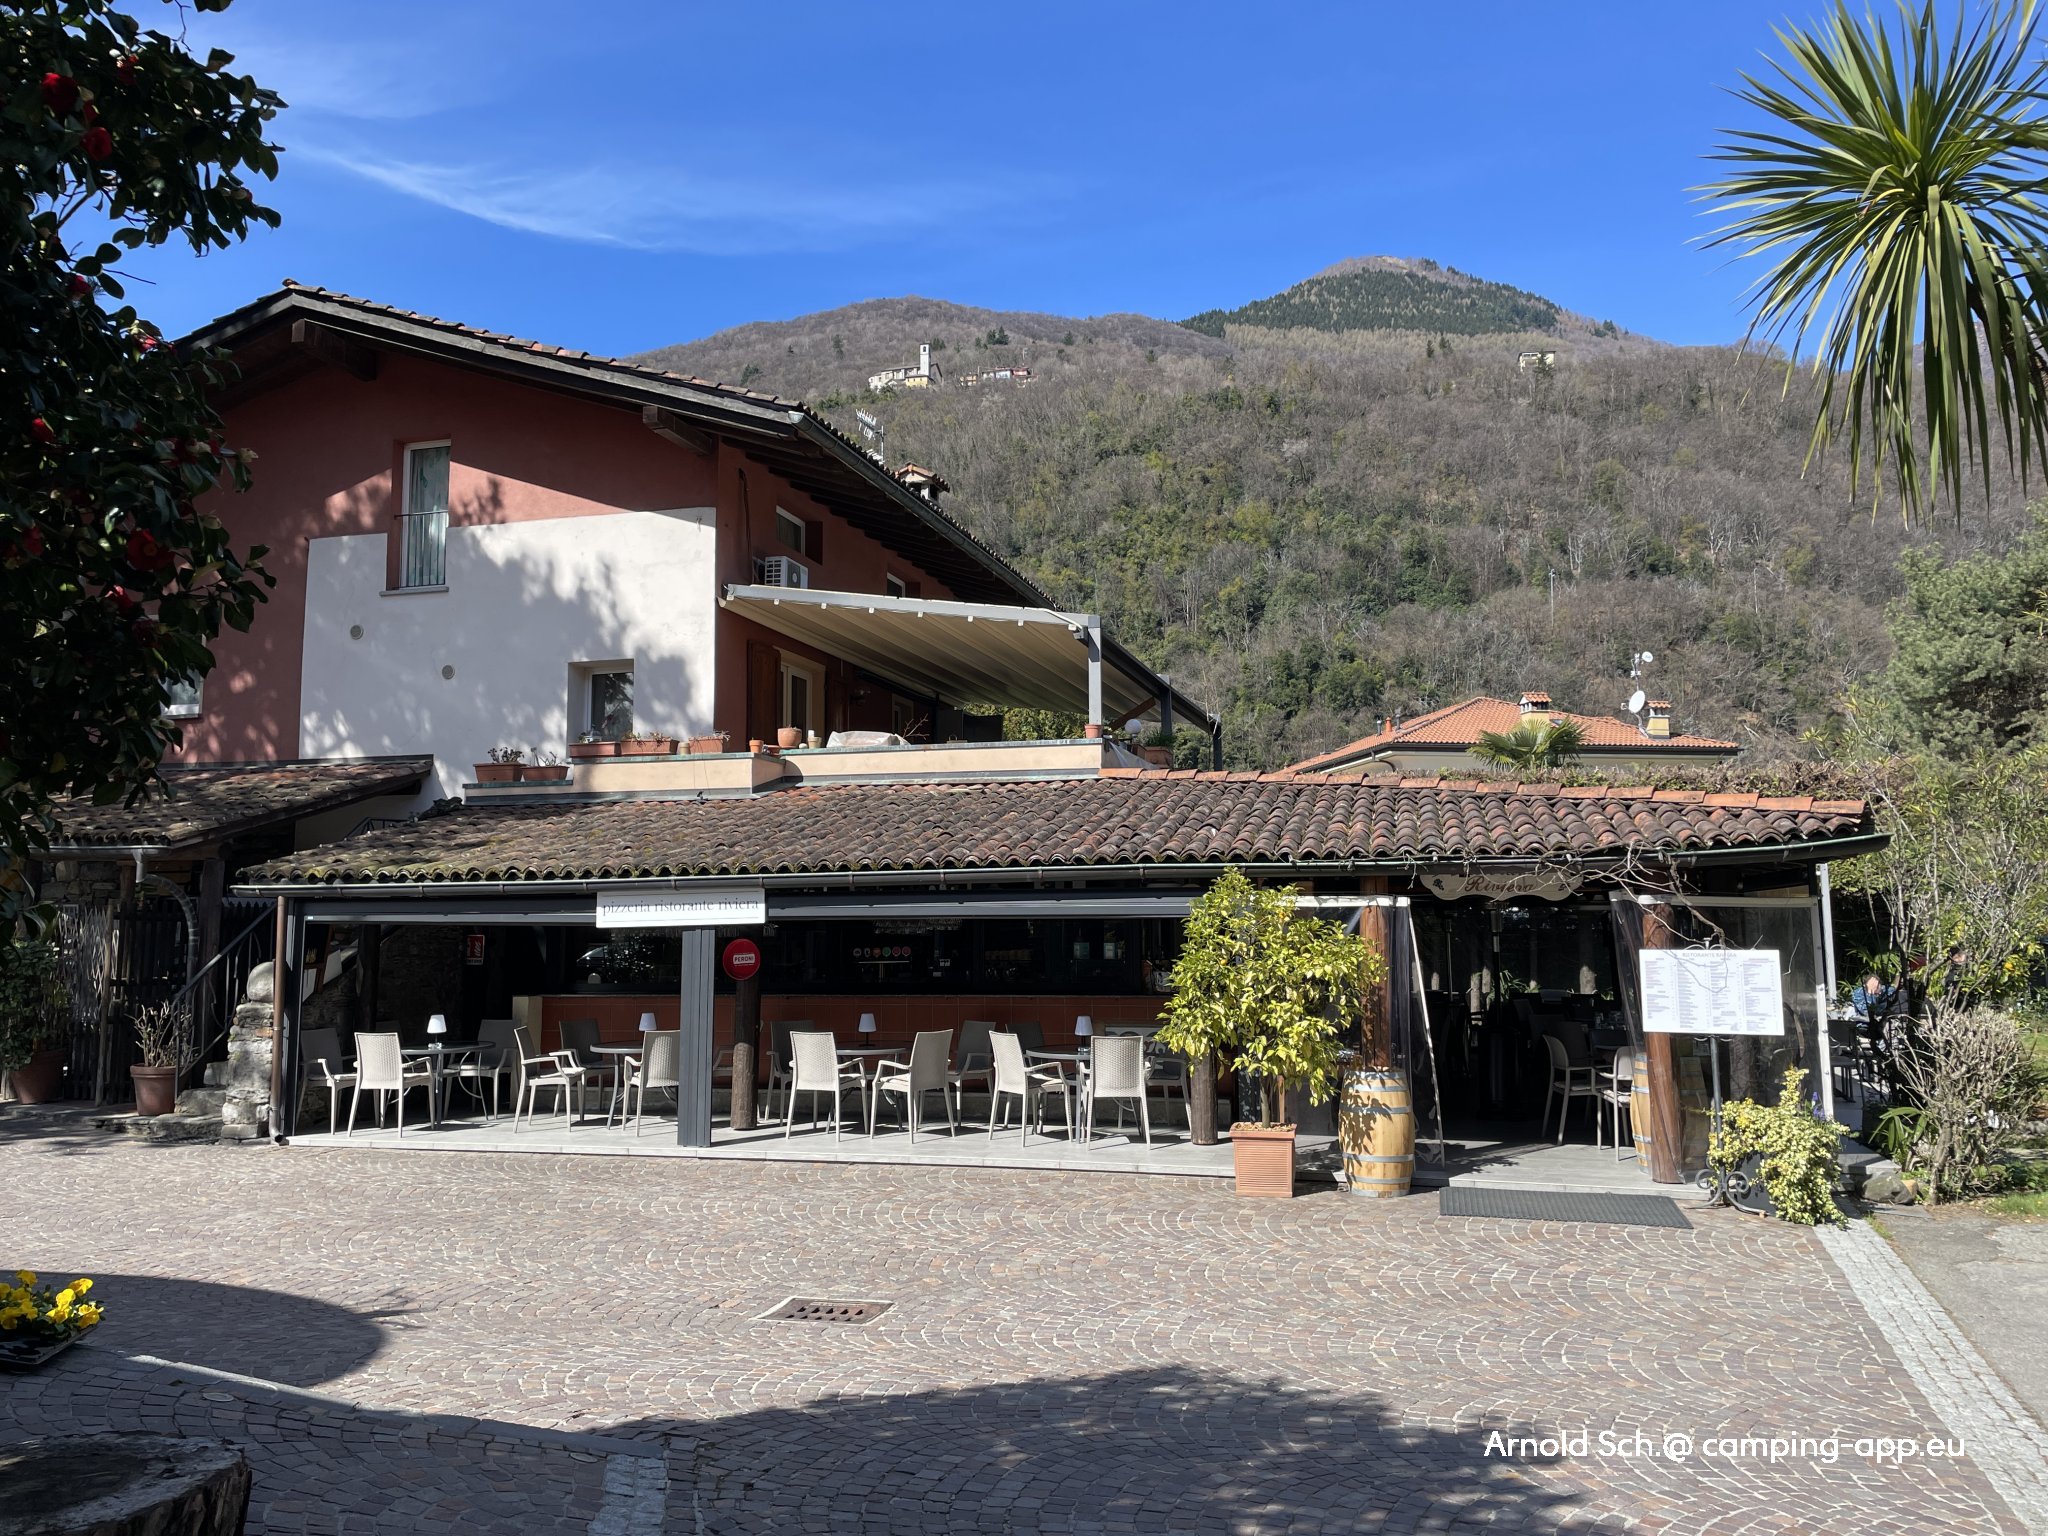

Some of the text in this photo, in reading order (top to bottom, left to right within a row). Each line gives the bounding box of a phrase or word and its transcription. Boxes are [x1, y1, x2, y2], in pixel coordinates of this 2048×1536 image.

[1464, 876, 1535, 893] Riviera
[602, 897, 759, 916] pizzeria ristorante riviera
[734, 955, 754, 963] PERONI
